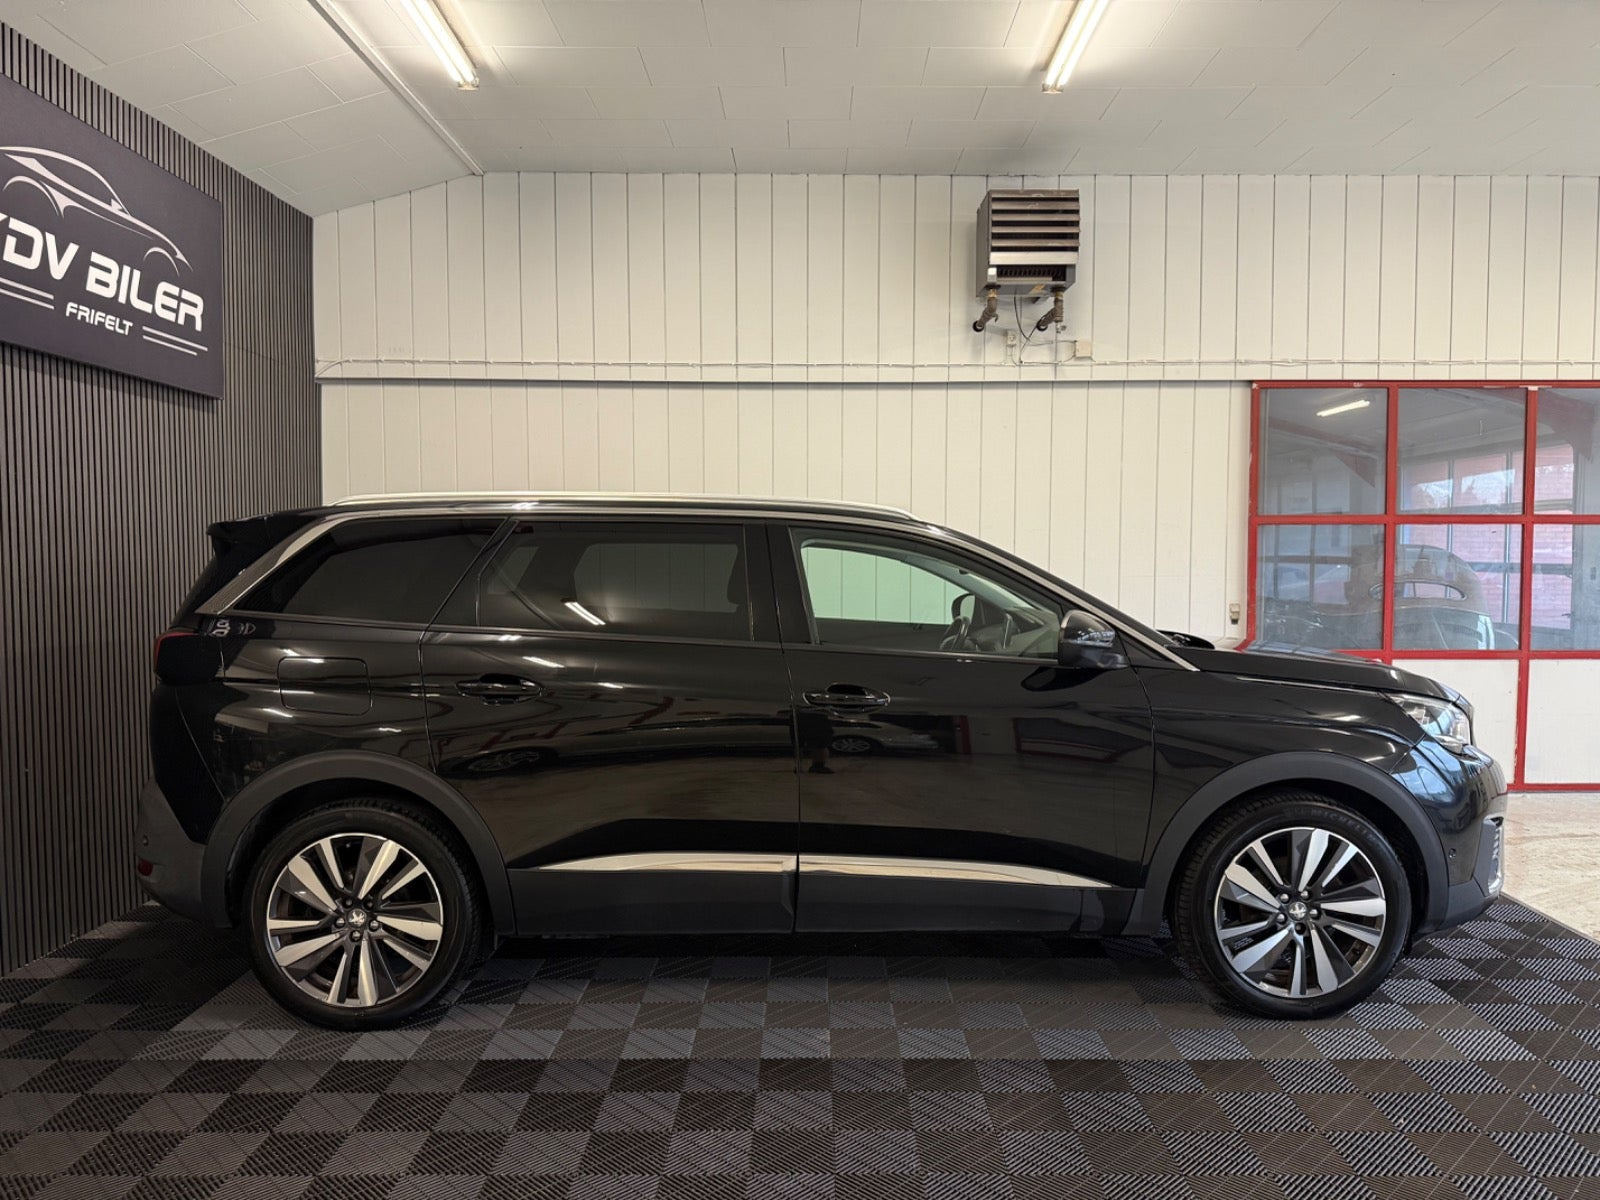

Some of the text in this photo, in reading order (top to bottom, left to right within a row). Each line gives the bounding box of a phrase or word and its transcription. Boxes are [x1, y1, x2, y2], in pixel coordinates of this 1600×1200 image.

[0, 212, 204, 332] DV BILER
[65, 301, 134, 336] FRIFELT
